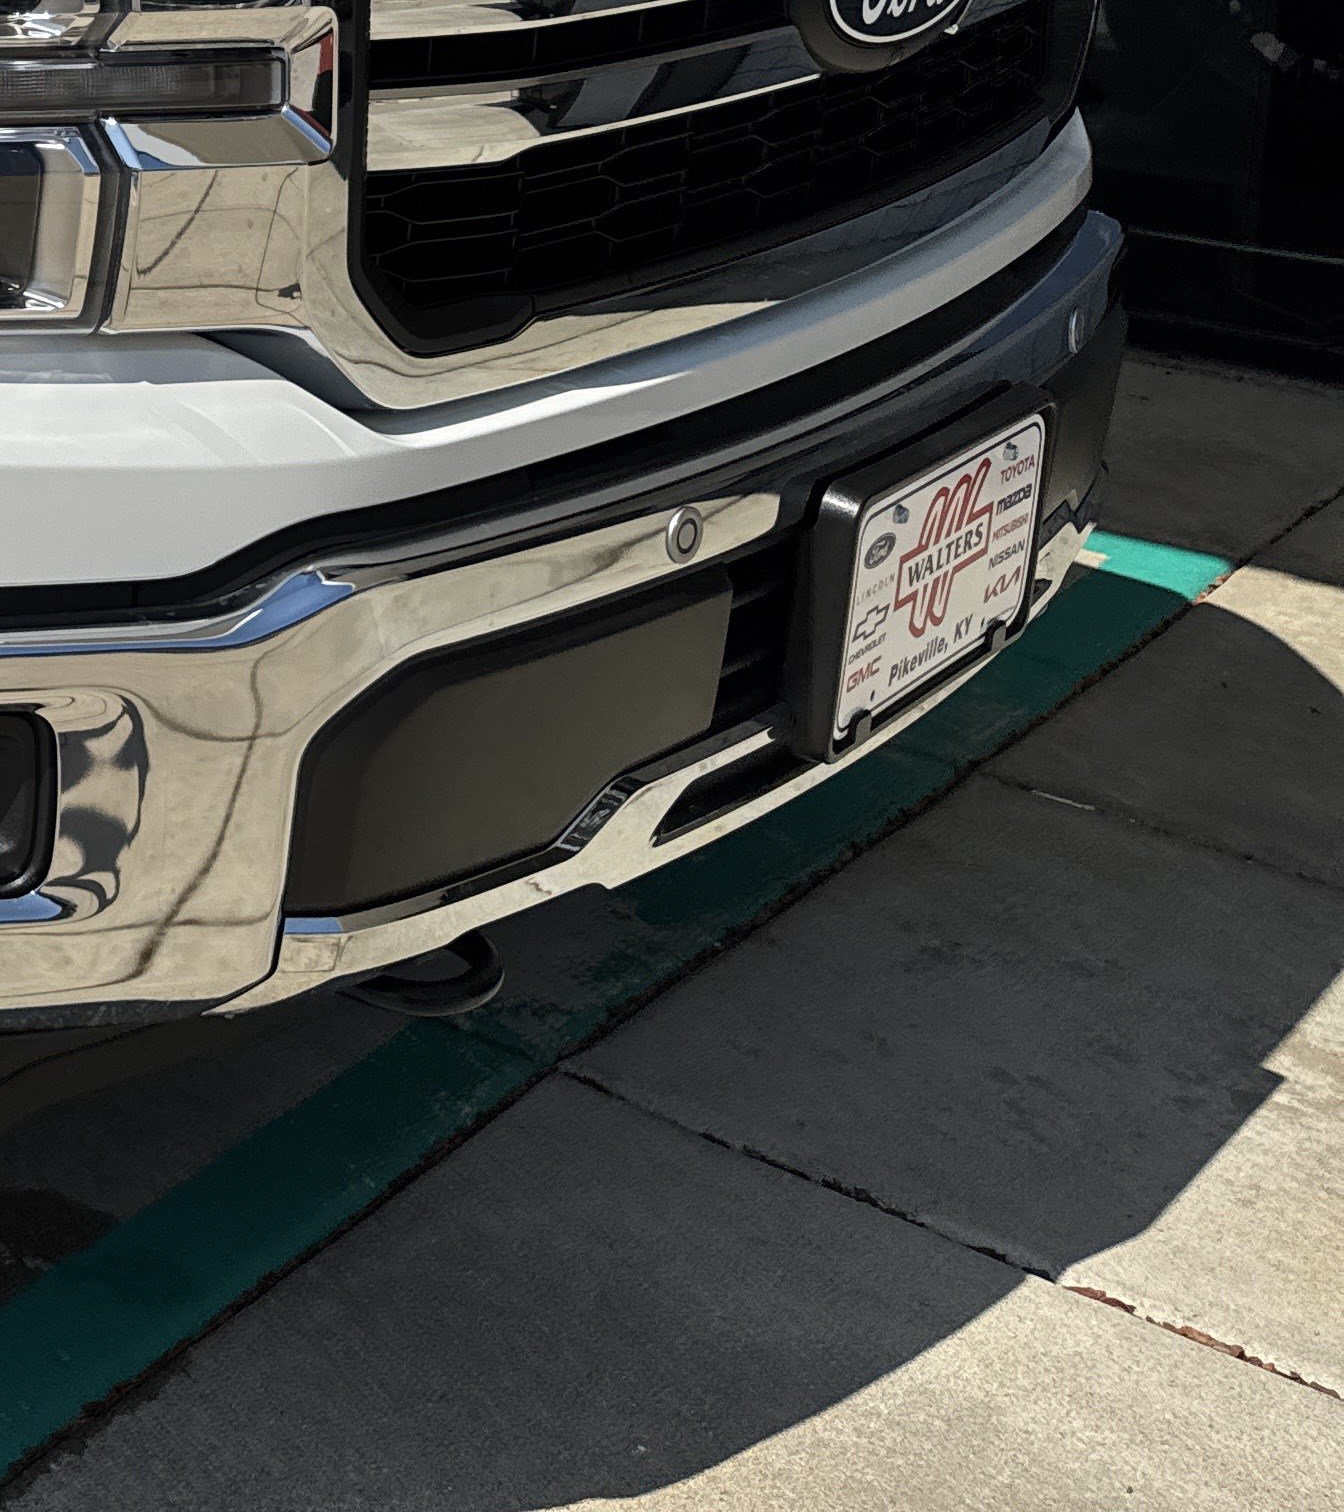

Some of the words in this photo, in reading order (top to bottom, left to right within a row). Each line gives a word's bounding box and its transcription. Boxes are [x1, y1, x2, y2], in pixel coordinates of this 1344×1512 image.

[1000, 453, 1035, 485] TOYOTA
[996, 483, 1033, 517] mazda
[908, 522, 984, 588] WALTERS
[988, 538, 1026, 570] NISSAN
[856, 573, 896, 606] LINCOLN
[847, 632, 887, 665] CHEVROLET
[888, 635, 949, 687] Pikeville,
[953, 613, 973, 643] KY
[846, 655, 883, 694] GMC
